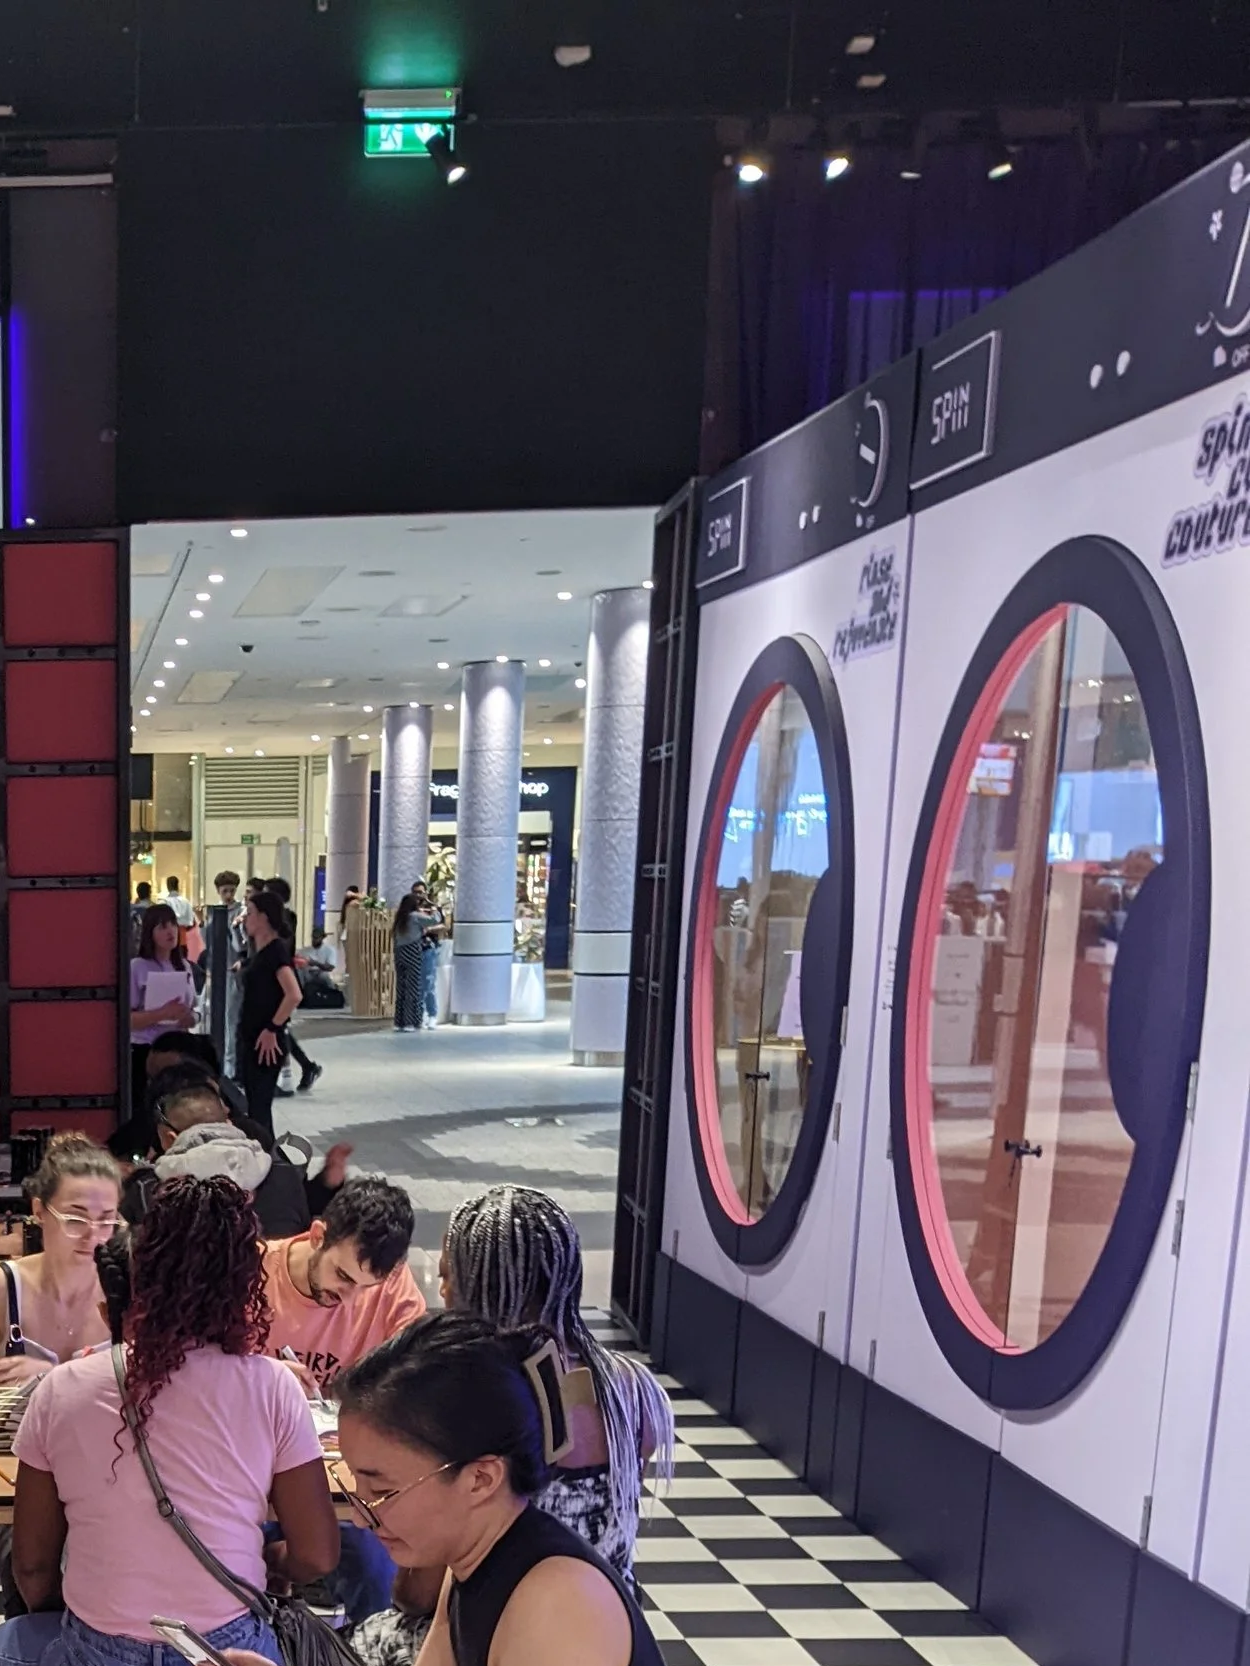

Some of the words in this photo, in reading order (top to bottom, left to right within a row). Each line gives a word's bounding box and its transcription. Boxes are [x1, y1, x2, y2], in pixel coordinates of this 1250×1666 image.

[931, 381, 970, 445] SPIN
[707, 512, 732, 557] SPIN
[519, 780, 549, 797] hop
